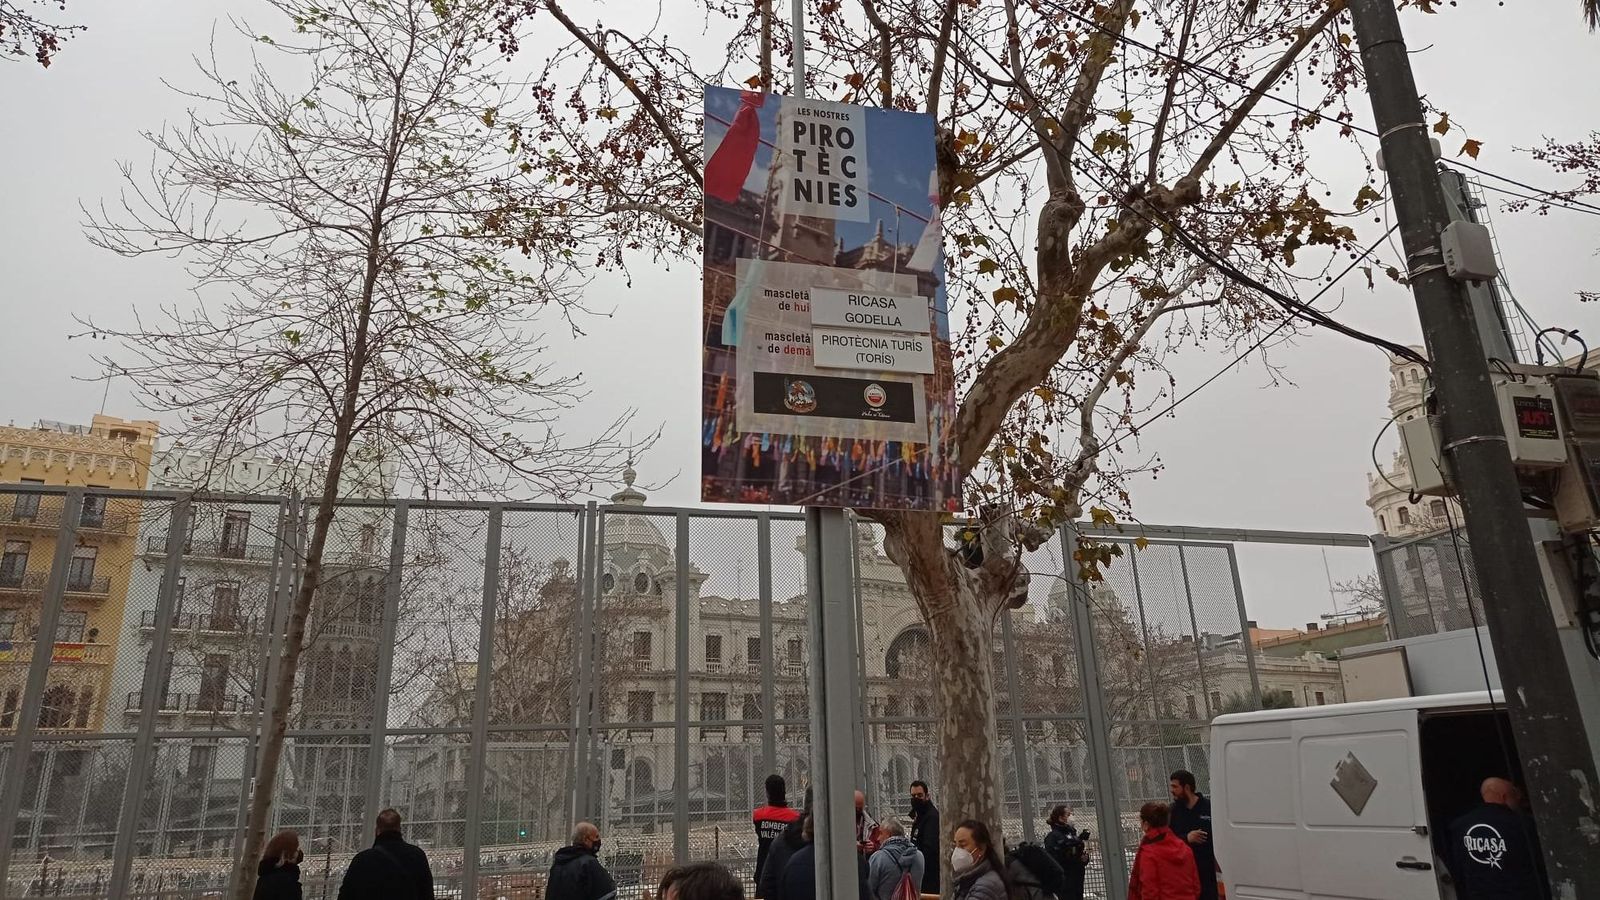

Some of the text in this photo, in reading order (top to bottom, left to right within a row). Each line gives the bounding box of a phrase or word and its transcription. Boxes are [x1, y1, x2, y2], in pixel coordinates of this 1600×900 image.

[797, 107, 850, 121] LES NOSTRES
[793, 120, 855, 150] PIRO
[794, 178, 858, 208] NIES
[778, 301, 810, 313] de hui
[848, 294, 897, 310] RICASA
[845, 312, 902, 327] GODELLA
[821, 332, 923, 352] PIROTÈCNIA TURÍS
[767, 343, 811, 357] de demà
[856, 352, 895, 367] (TORÍS)
[1463, 835, 1507, 853] RICASA
